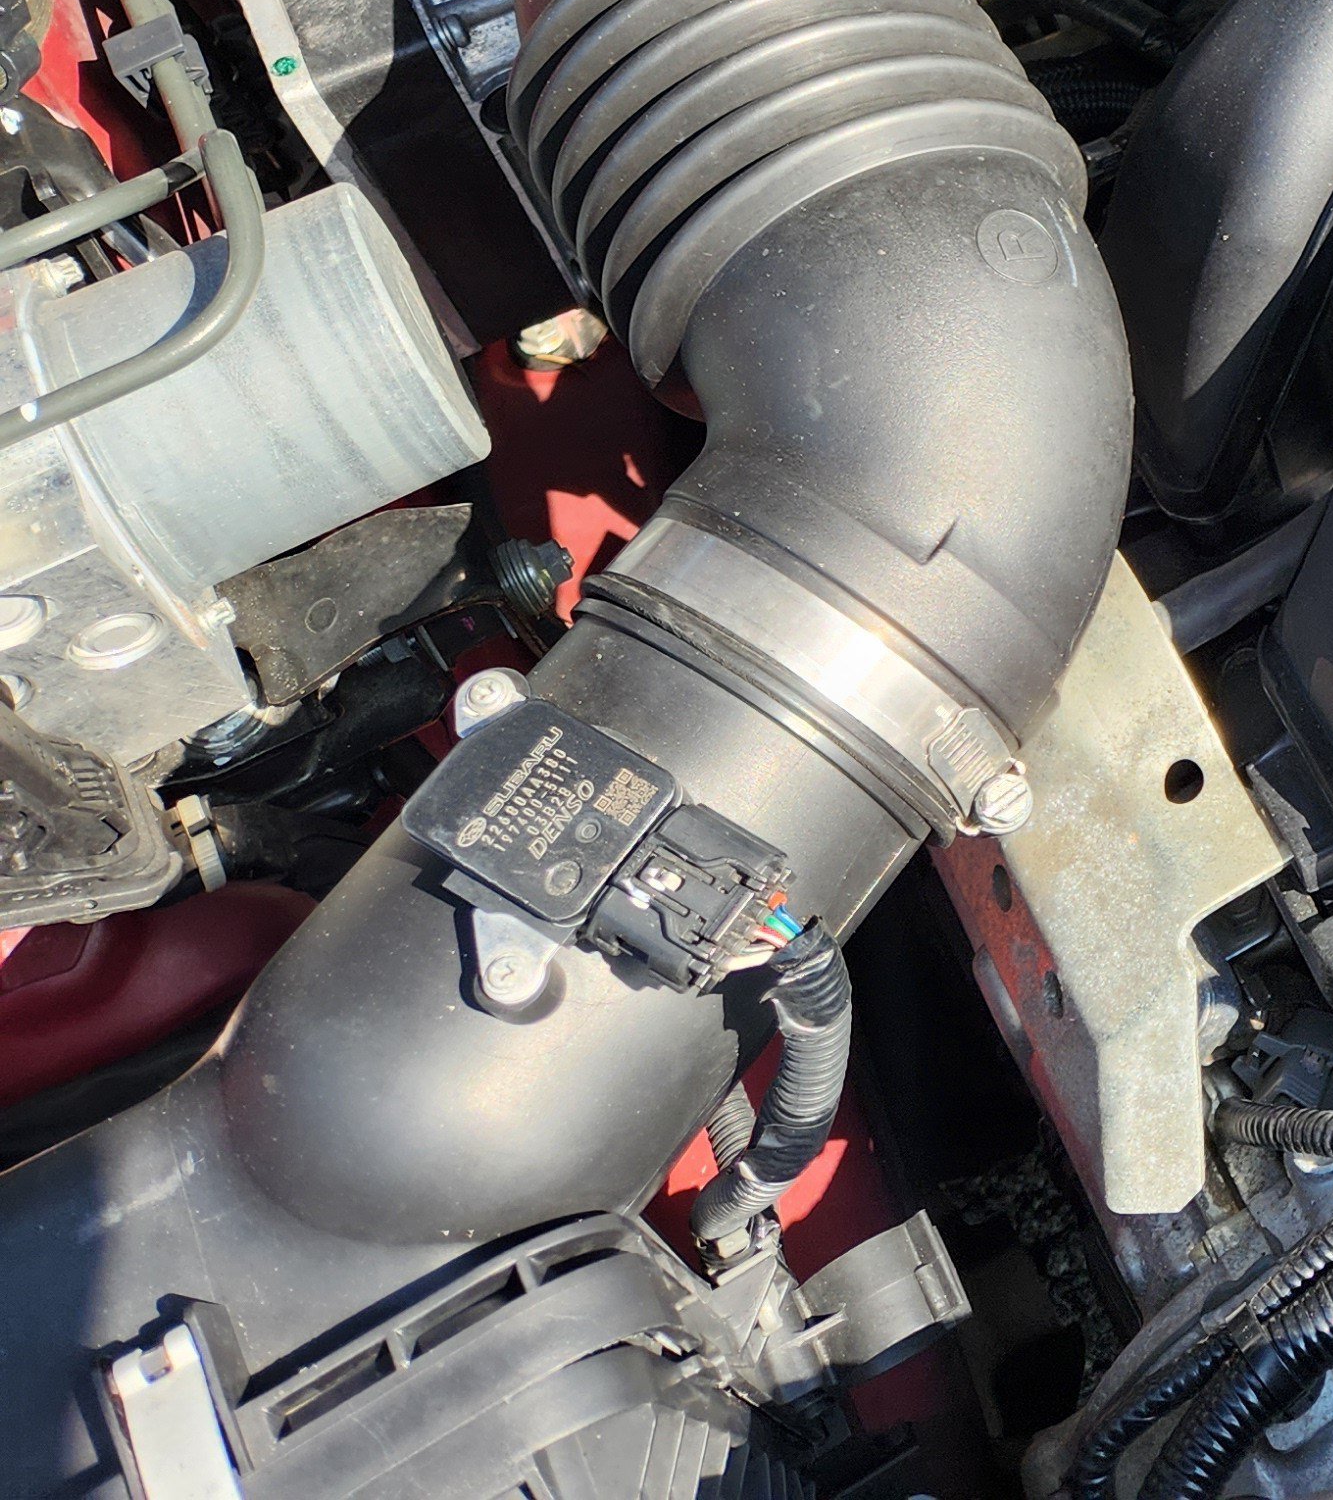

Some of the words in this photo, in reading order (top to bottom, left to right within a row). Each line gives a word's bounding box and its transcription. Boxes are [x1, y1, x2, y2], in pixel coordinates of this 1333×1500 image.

[481, 748, 567, 846] 22680AA380
[483, 726, 564, 818] SUBARU
[528, 779, 595, 860] DENSO
